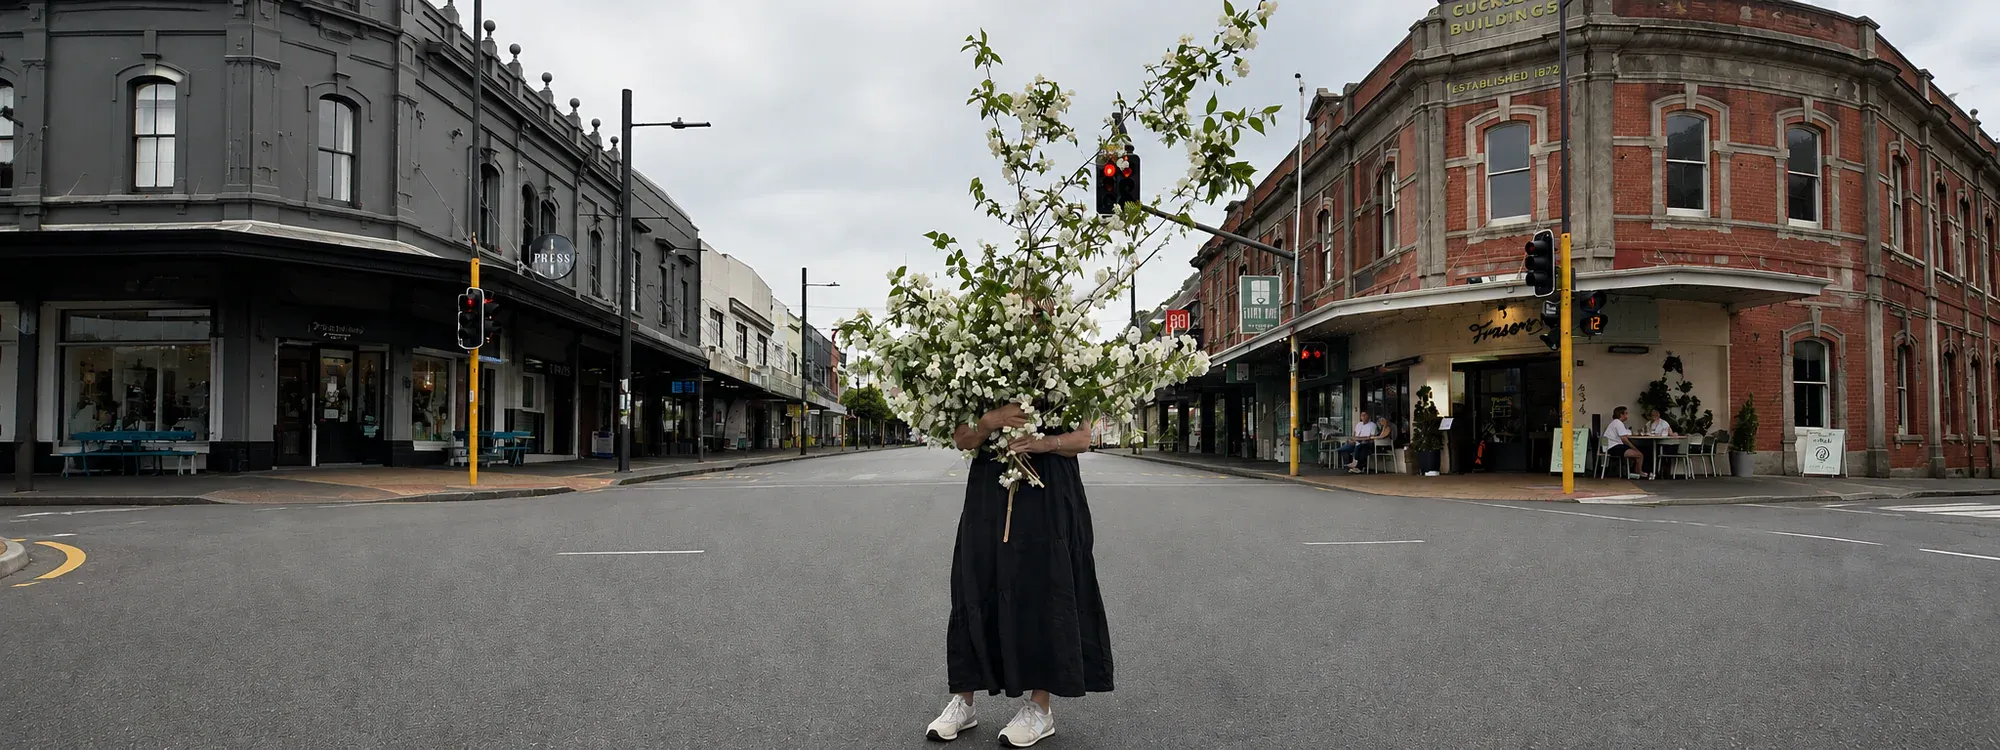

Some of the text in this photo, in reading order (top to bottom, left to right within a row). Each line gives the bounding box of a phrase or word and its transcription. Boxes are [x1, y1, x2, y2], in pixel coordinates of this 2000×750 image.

[1450, 0, 1558, 35] BUILDINGS
[1452, 65, 1560, 94] ESTABLISHED 1872
[534, 253, 570, 264] PRESS
[1590, 316, 1601, 330] 12
